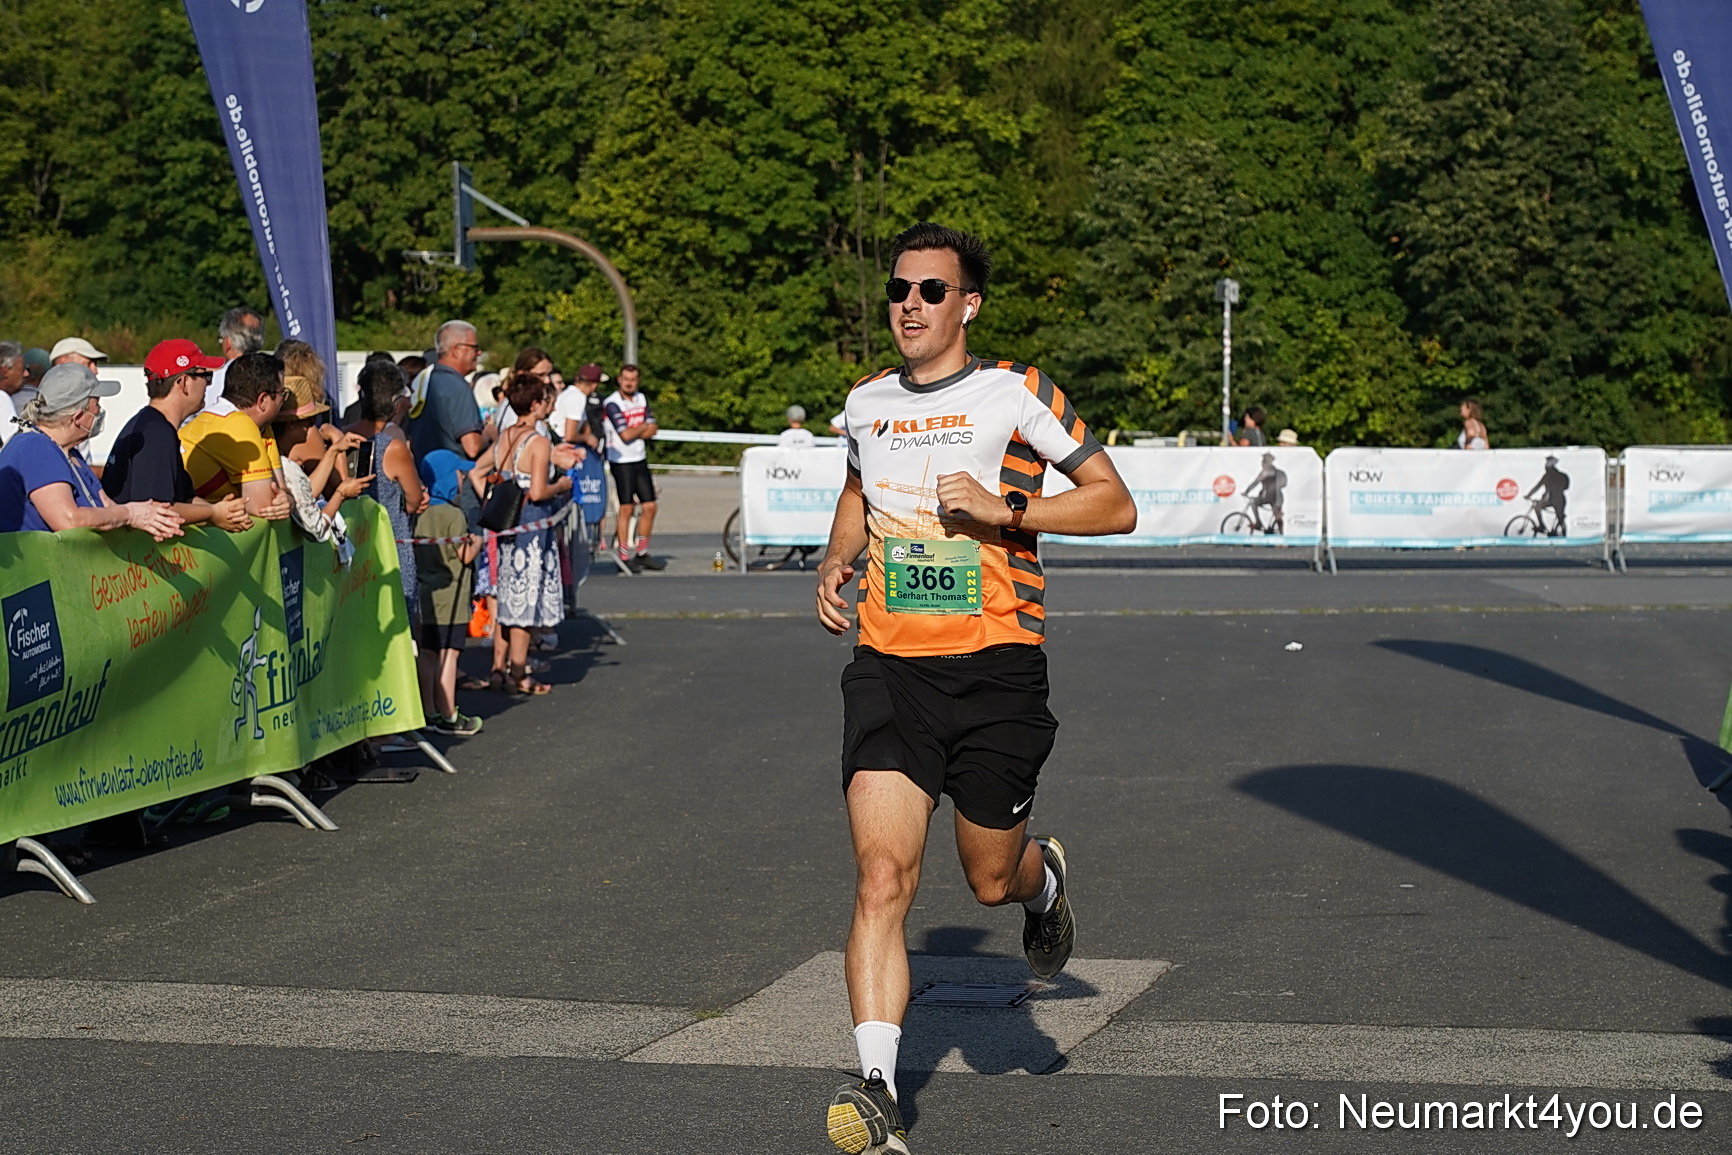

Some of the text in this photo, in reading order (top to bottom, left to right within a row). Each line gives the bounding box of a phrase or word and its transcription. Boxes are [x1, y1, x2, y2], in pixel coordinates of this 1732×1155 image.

[892, 414, 975, 434] KLEBL
[890, 431, 974, 451] DYNAMICS
[766, 467, 802, 481] NOW
[1348, 471, 1383, 483] NOW
[1649, 470, 1685, 482] NOW
[1351, 492, 1402, 505] E-BIKES
[91, 546, 199, 611] Gesunde Firmen
[889, 571, 898, 598] RUN
[905, 565, 956, 591] 366
[966, 569, 978, 604] 2022
[896, 590, 968, 602] Gerhart Thomas
[127, 600, 168, 650] laufen
[17, 621, 51, 651] Fischer
[22, 640, 52, 661] AUTOMOBILE
[55, 740, 205, 808] www.firmenlauf-oberpfalz.de
